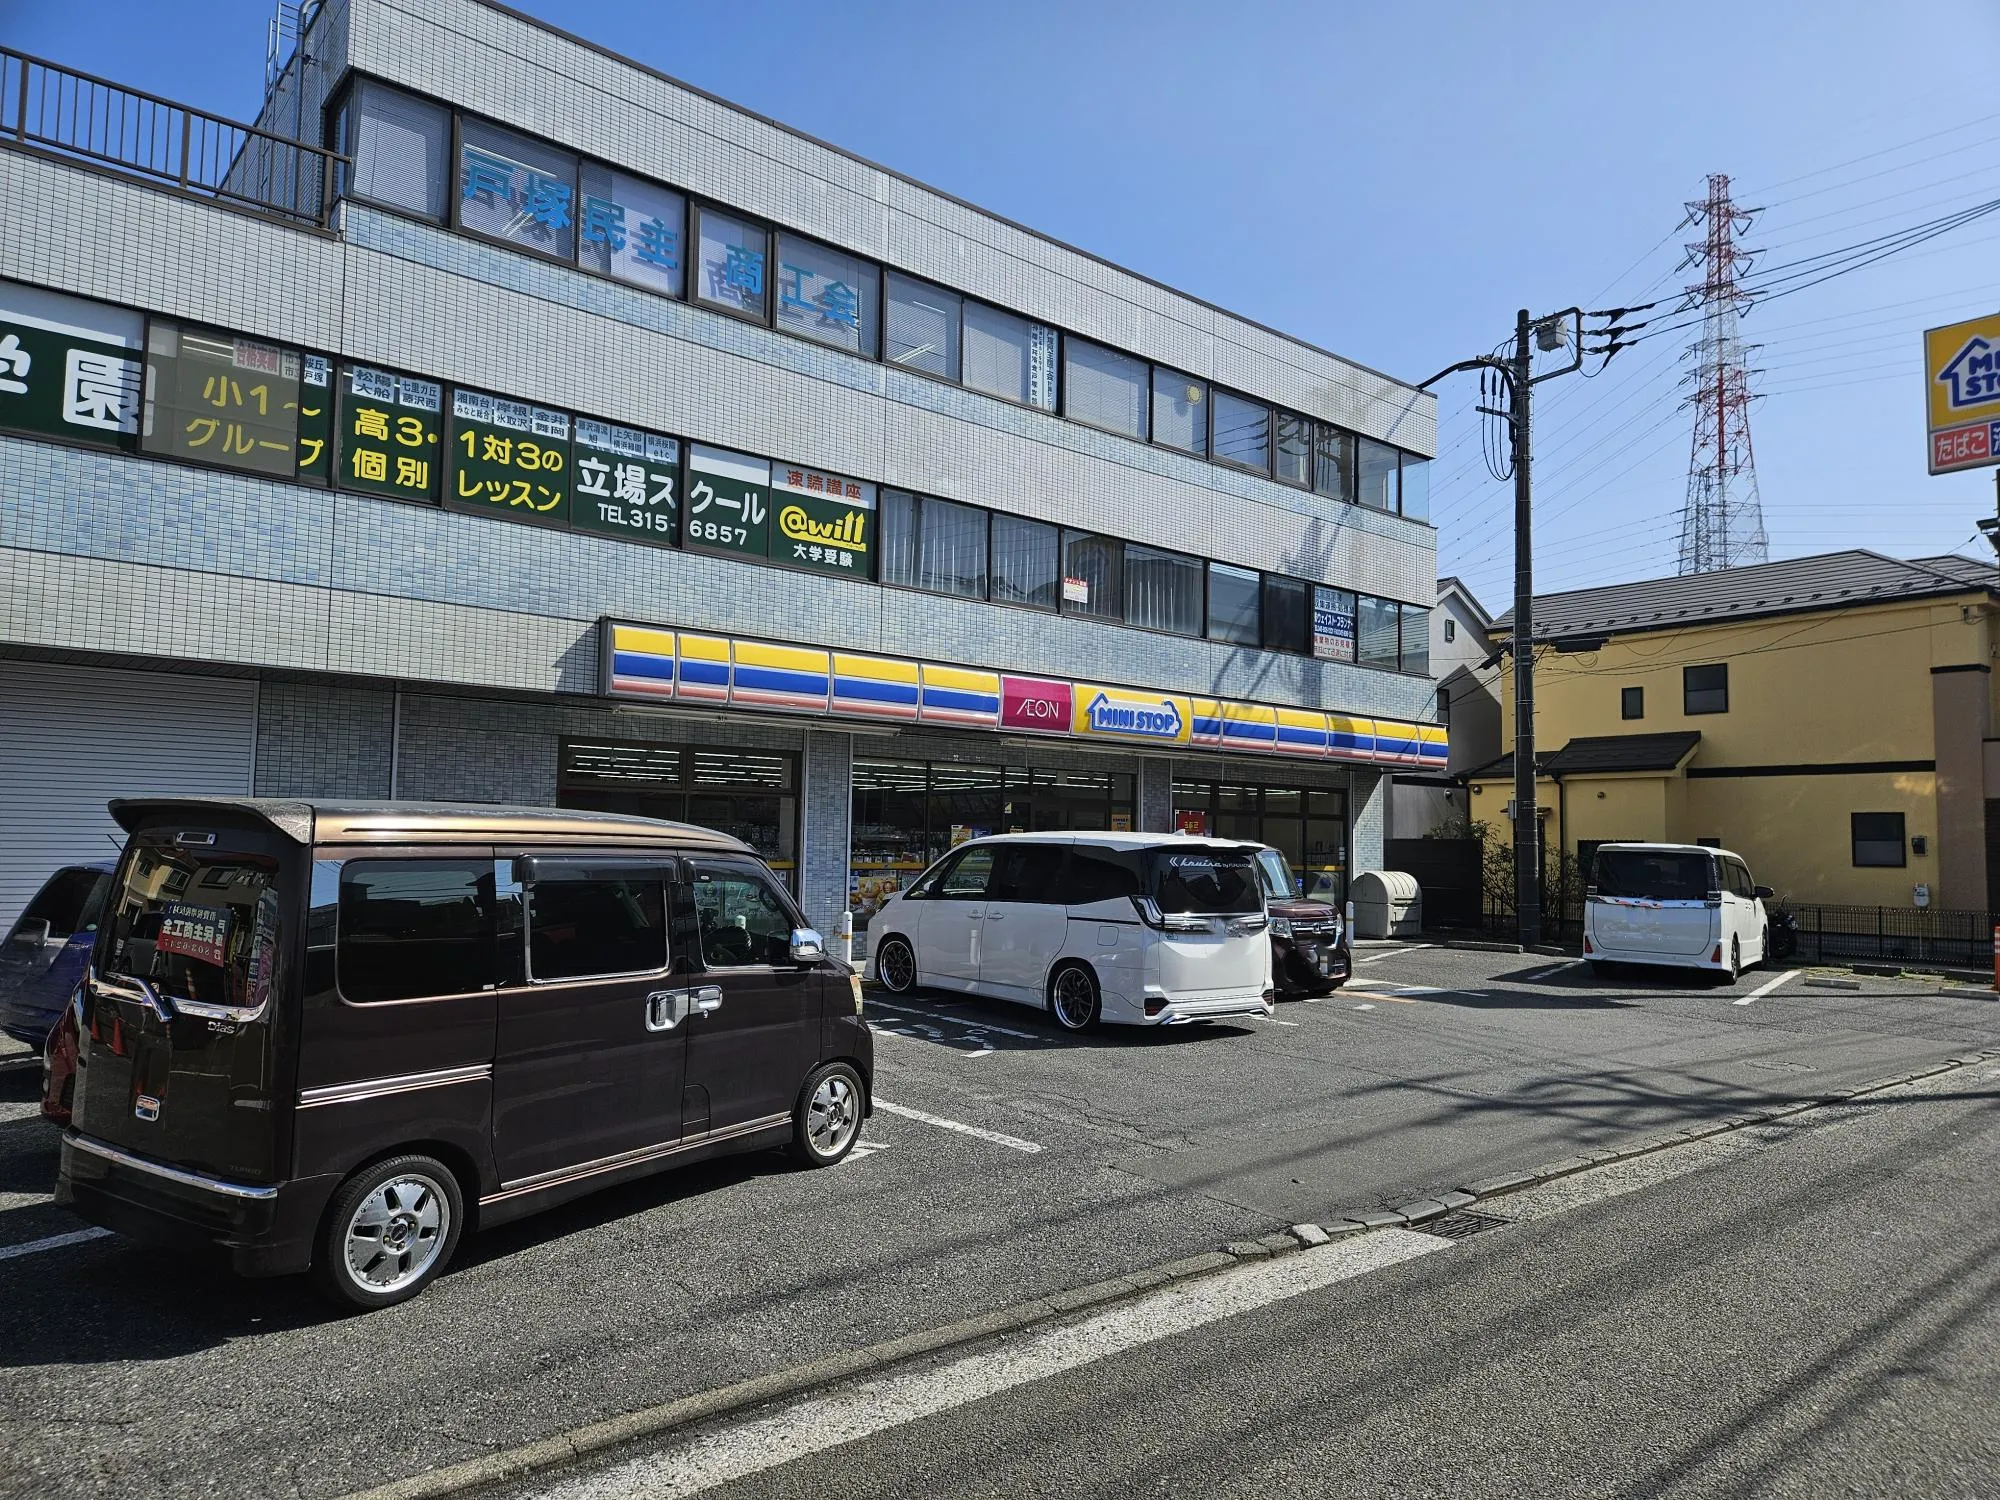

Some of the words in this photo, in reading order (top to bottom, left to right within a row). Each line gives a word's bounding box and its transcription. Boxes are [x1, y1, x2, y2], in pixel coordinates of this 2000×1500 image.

[464, 150, 860, 325] 戸塚民主商工会
[356, 384, 390, 399] 大船
[457, 392, 489, 408] 湘南台
[457, 405, 489, 420] みなと総合
[497, 402, 527, 417] 岸根
[536, 412, 566, 425] 金井
[614, 429, 642, 442] 上矢部
[1937, 431, 1986, 462] たばこ
[186, 418, 324, 467] グループ
[352, 448, 428, 489] 個別
[458, 470, 562, 511] レッスン
[787, 469, 861, 500] 速読講座
[793, 543, 853, 568] 大学受験
[207, 1021, 235, 1034] Dias
